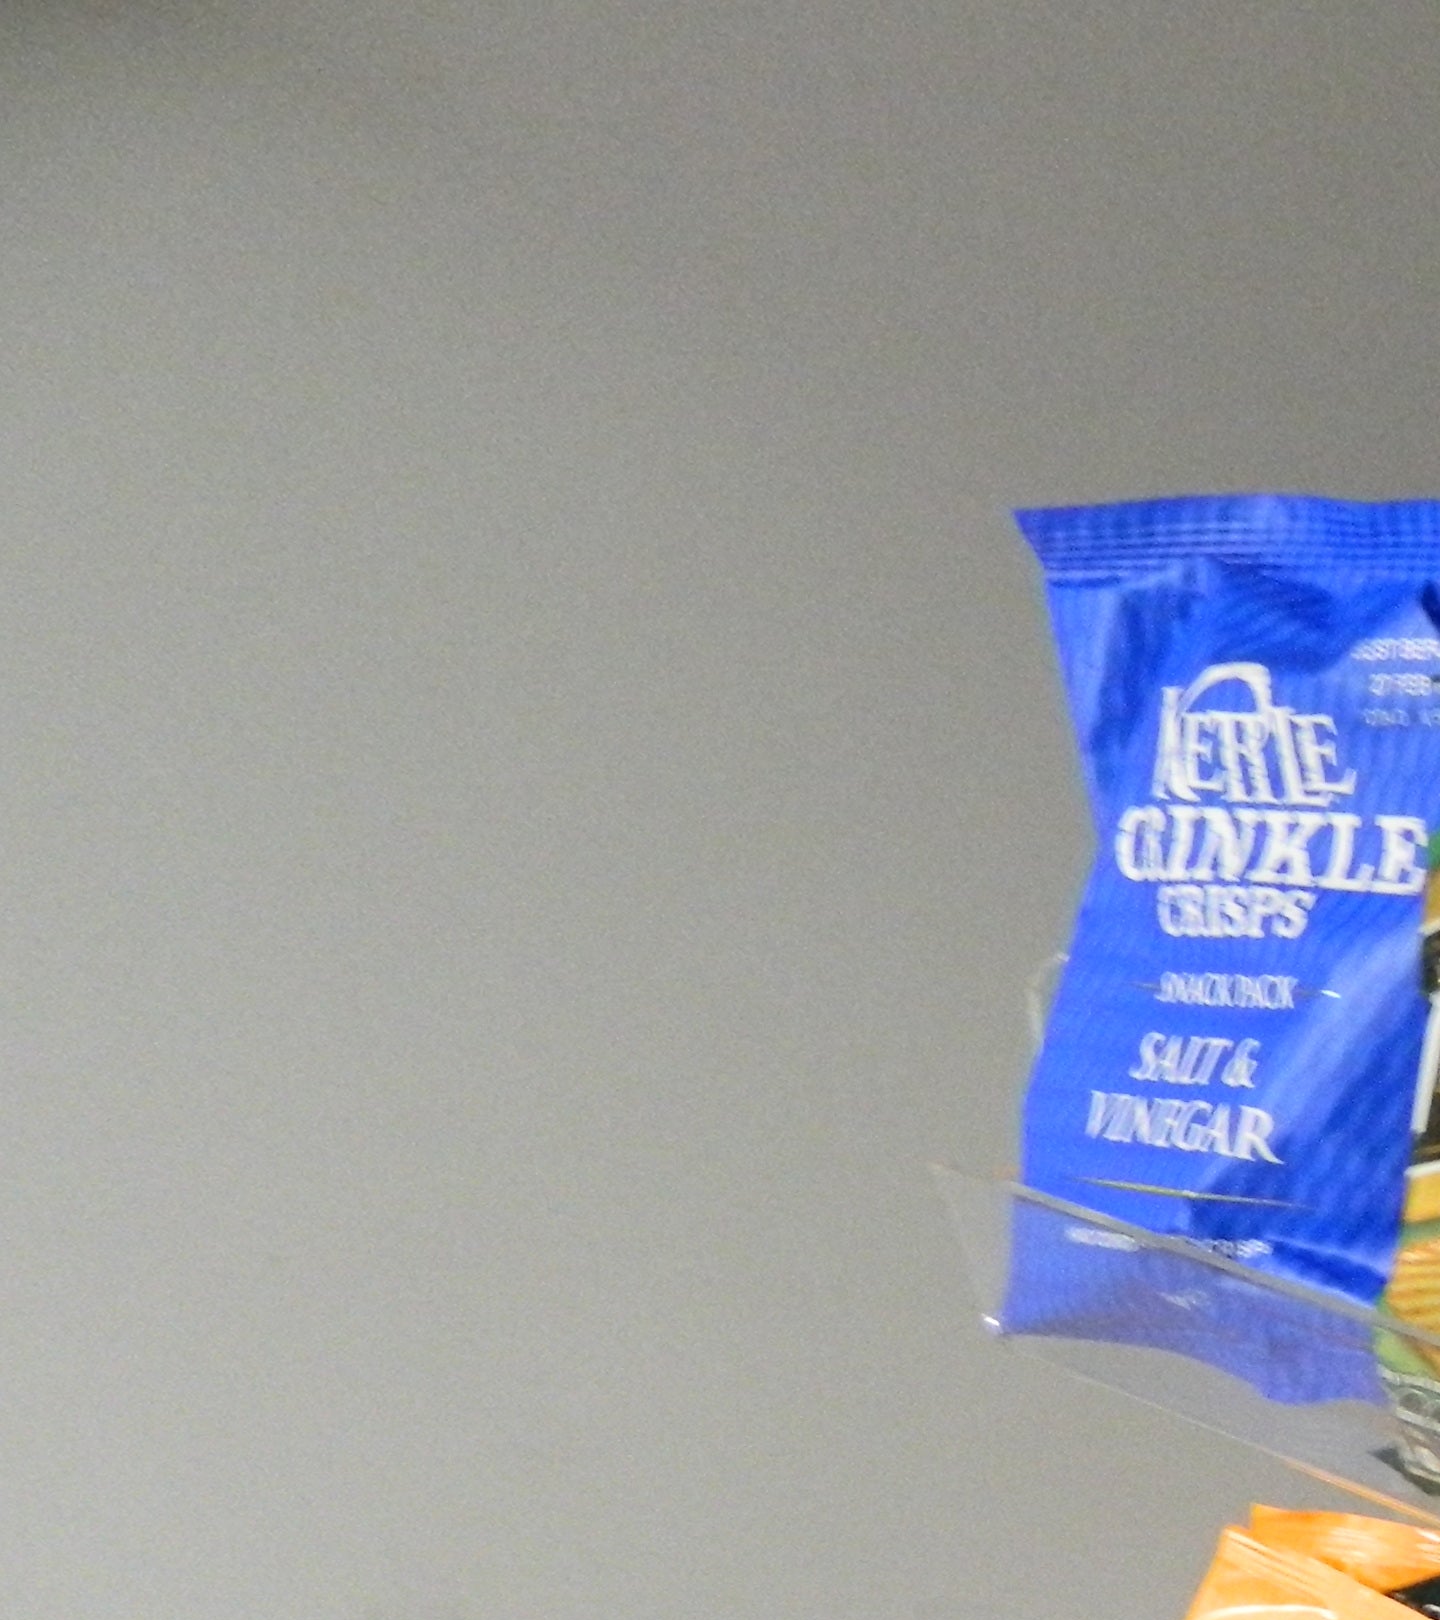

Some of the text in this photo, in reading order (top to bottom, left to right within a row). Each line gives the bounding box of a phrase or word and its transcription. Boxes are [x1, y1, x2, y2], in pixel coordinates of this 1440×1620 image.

[1157, 883, 1318, 939] CRISPS
[1130, 1031, 1262, 1089] SALT &
[1086, 1090, 1285, 1165] VINEGAR
